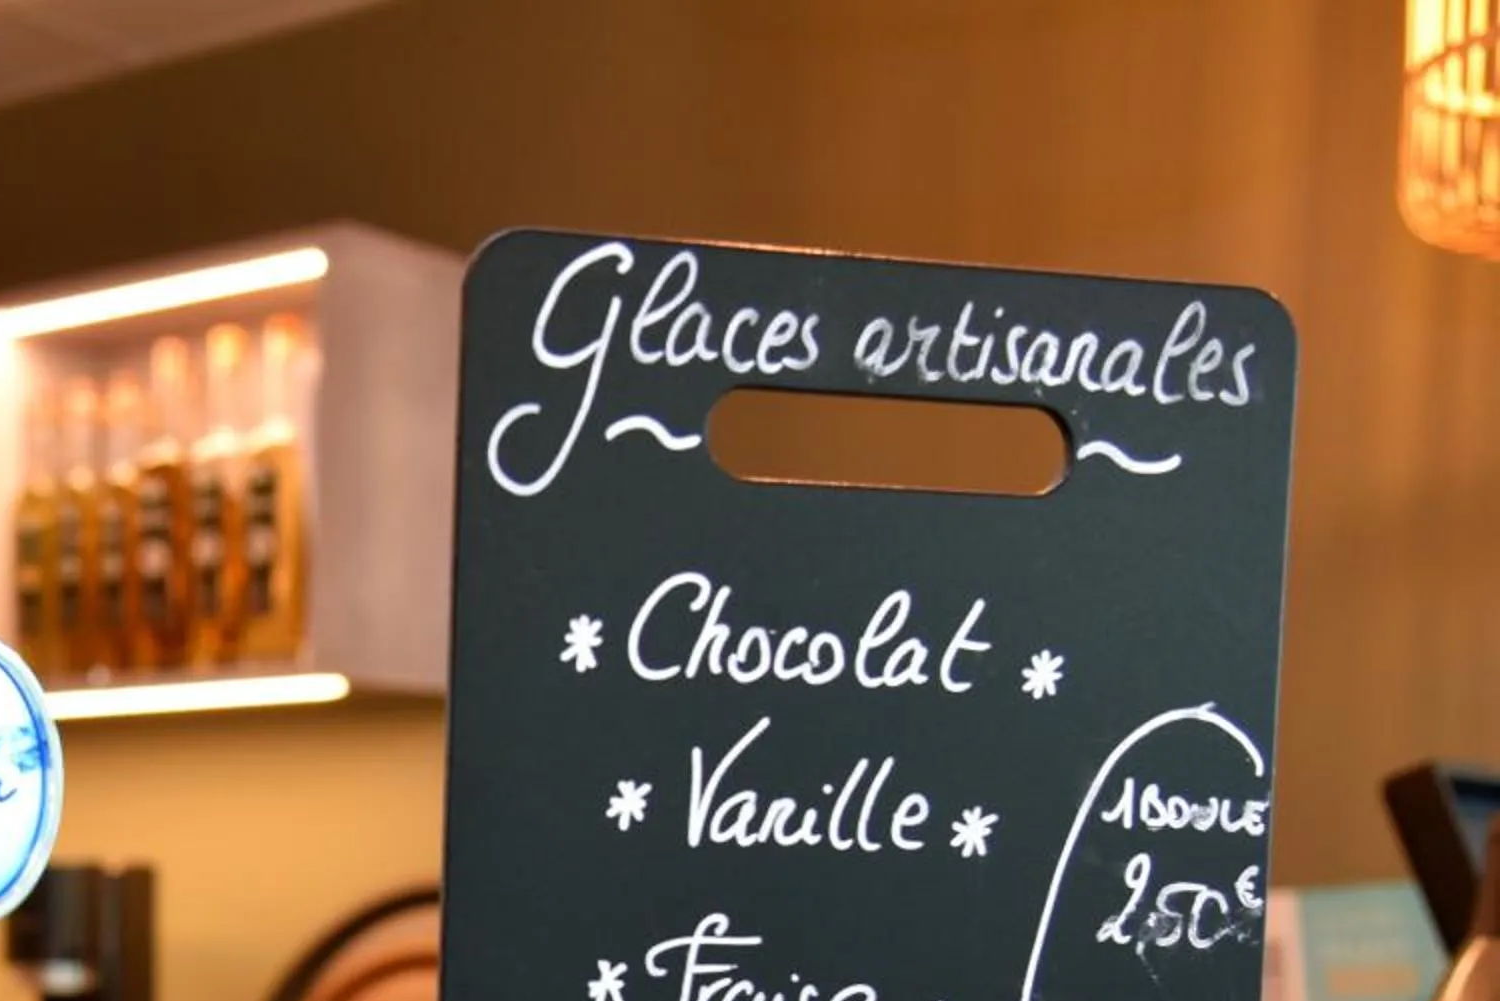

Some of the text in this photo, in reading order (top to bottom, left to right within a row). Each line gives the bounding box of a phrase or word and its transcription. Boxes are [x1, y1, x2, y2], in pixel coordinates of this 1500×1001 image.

[486, 240, 1257, 498] Glaces artisanales
[627, 570, 992, 694] Chocolat
[686, 715, 930, 851] Vanille
